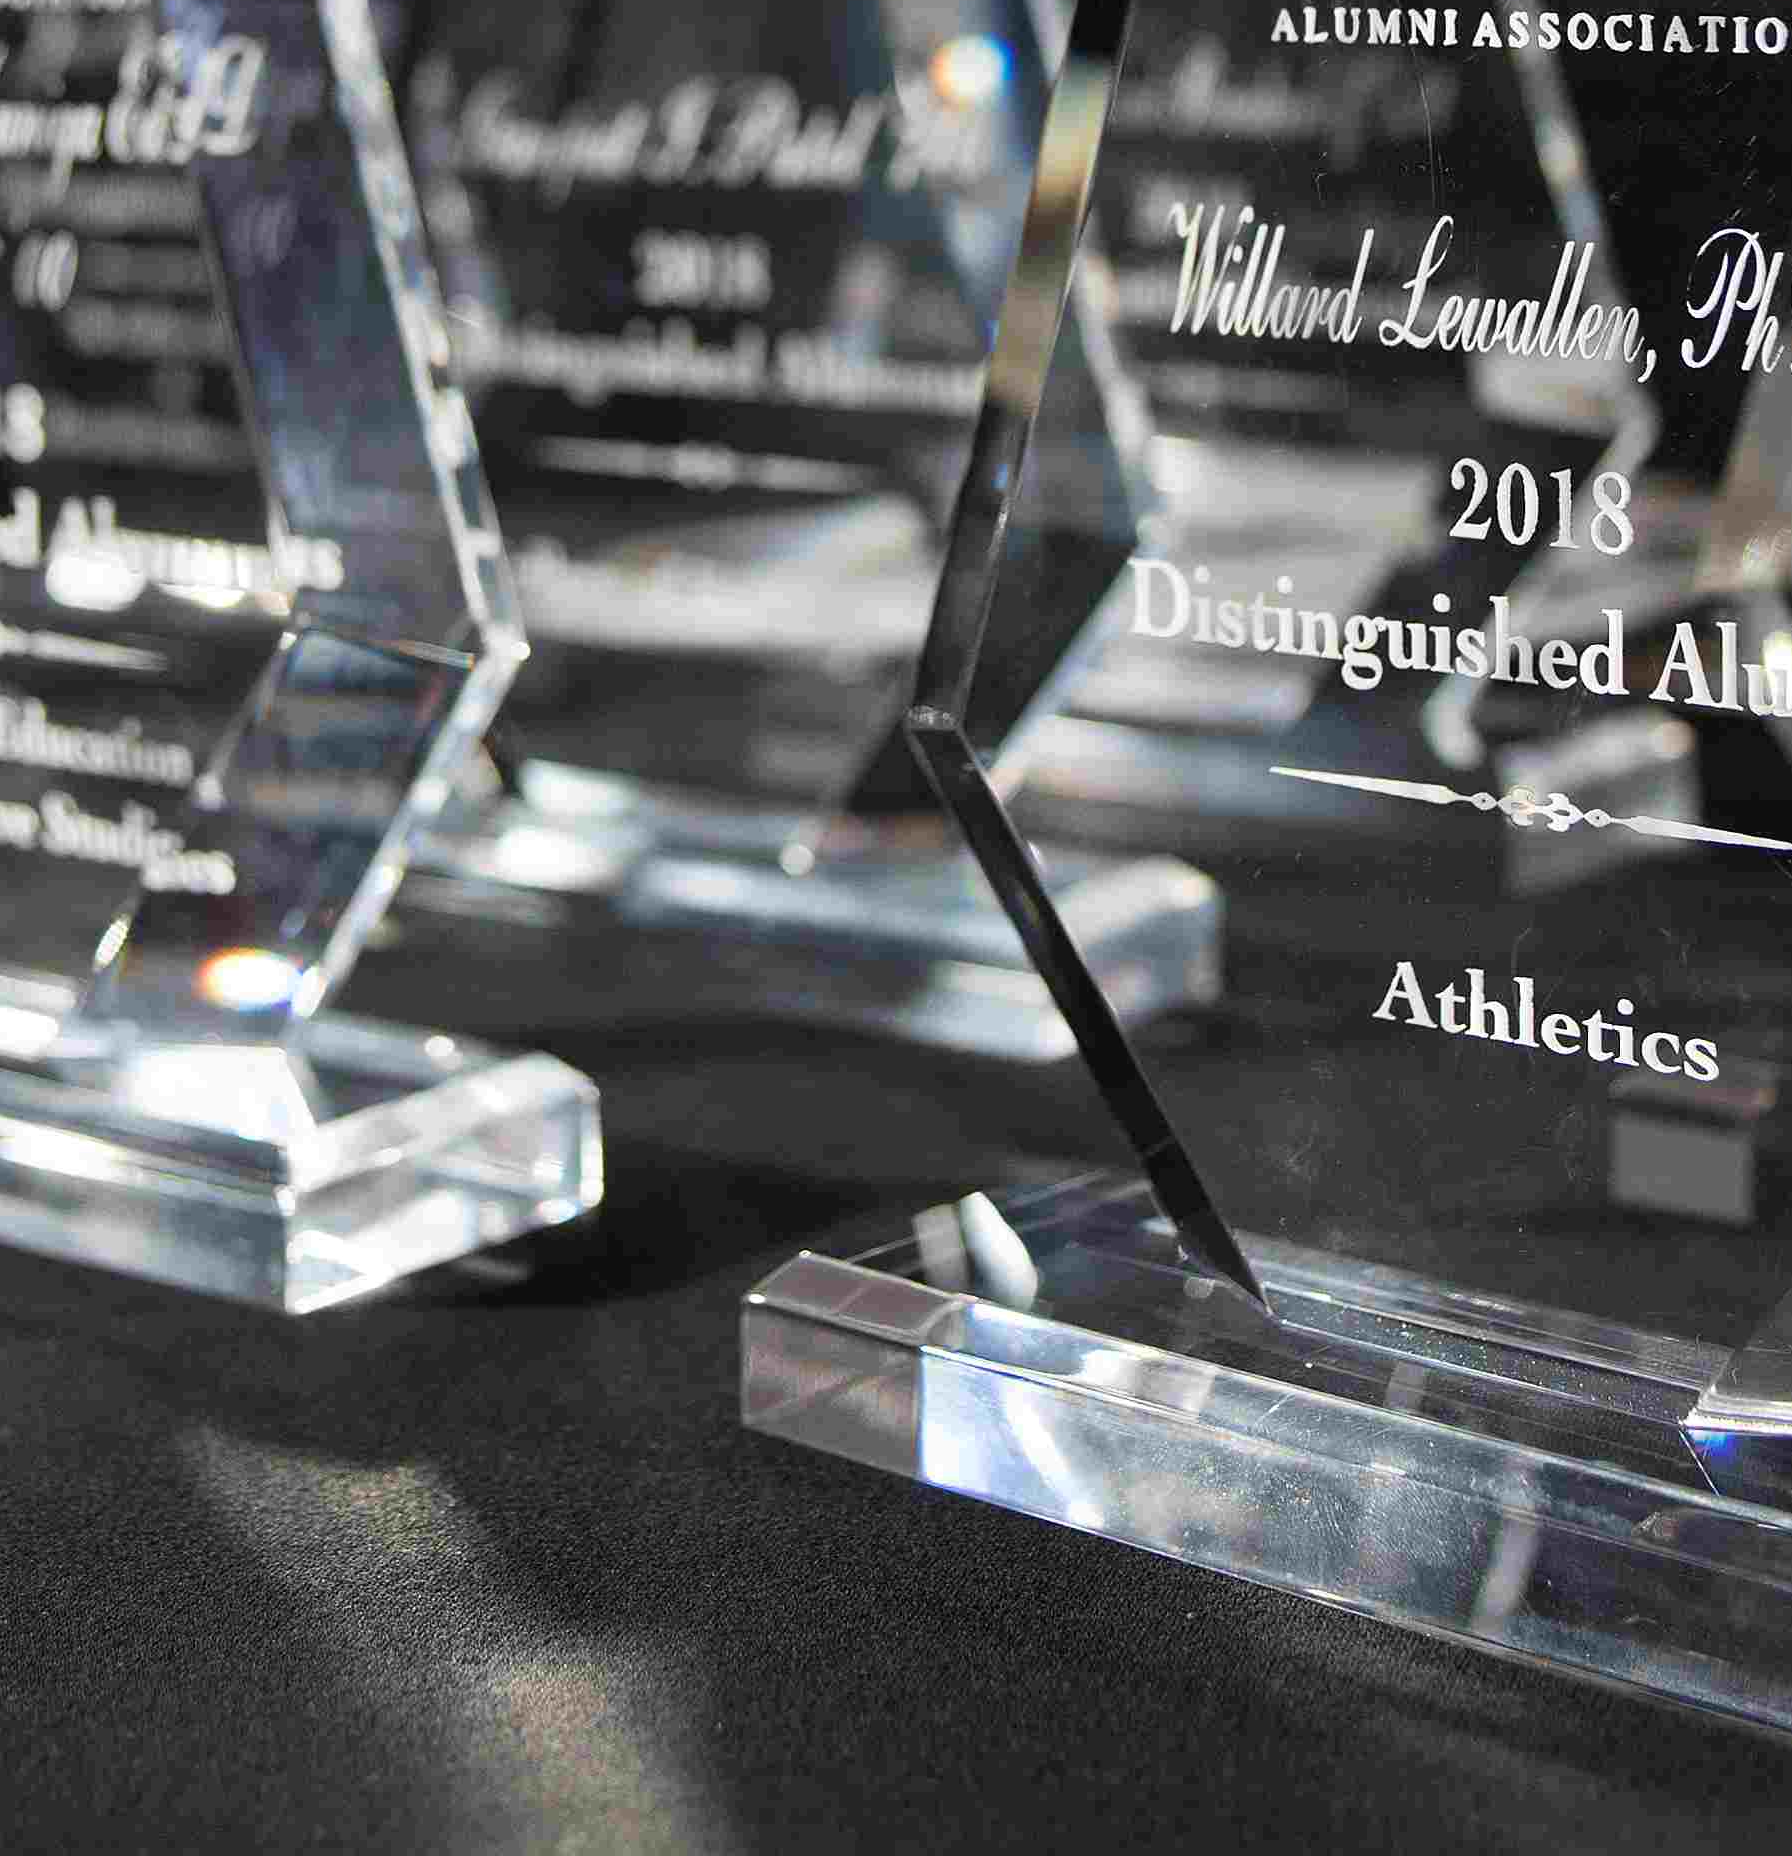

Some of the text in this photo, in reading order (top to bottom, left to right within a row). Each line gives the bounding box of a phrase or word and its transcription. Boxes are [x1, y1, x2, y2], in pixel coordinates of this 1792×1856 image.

[1271, 6, 1459, 47] ALUMNI
[1169, 201, 1374, 345] Willard
[1378, 215, 1657, 384] Lewallen,
[1448, 457, 1635, 557] 2018
[1129, 557, 1630, 697] Distinguished
[1371, 960, 1720, 1082] Athletics
